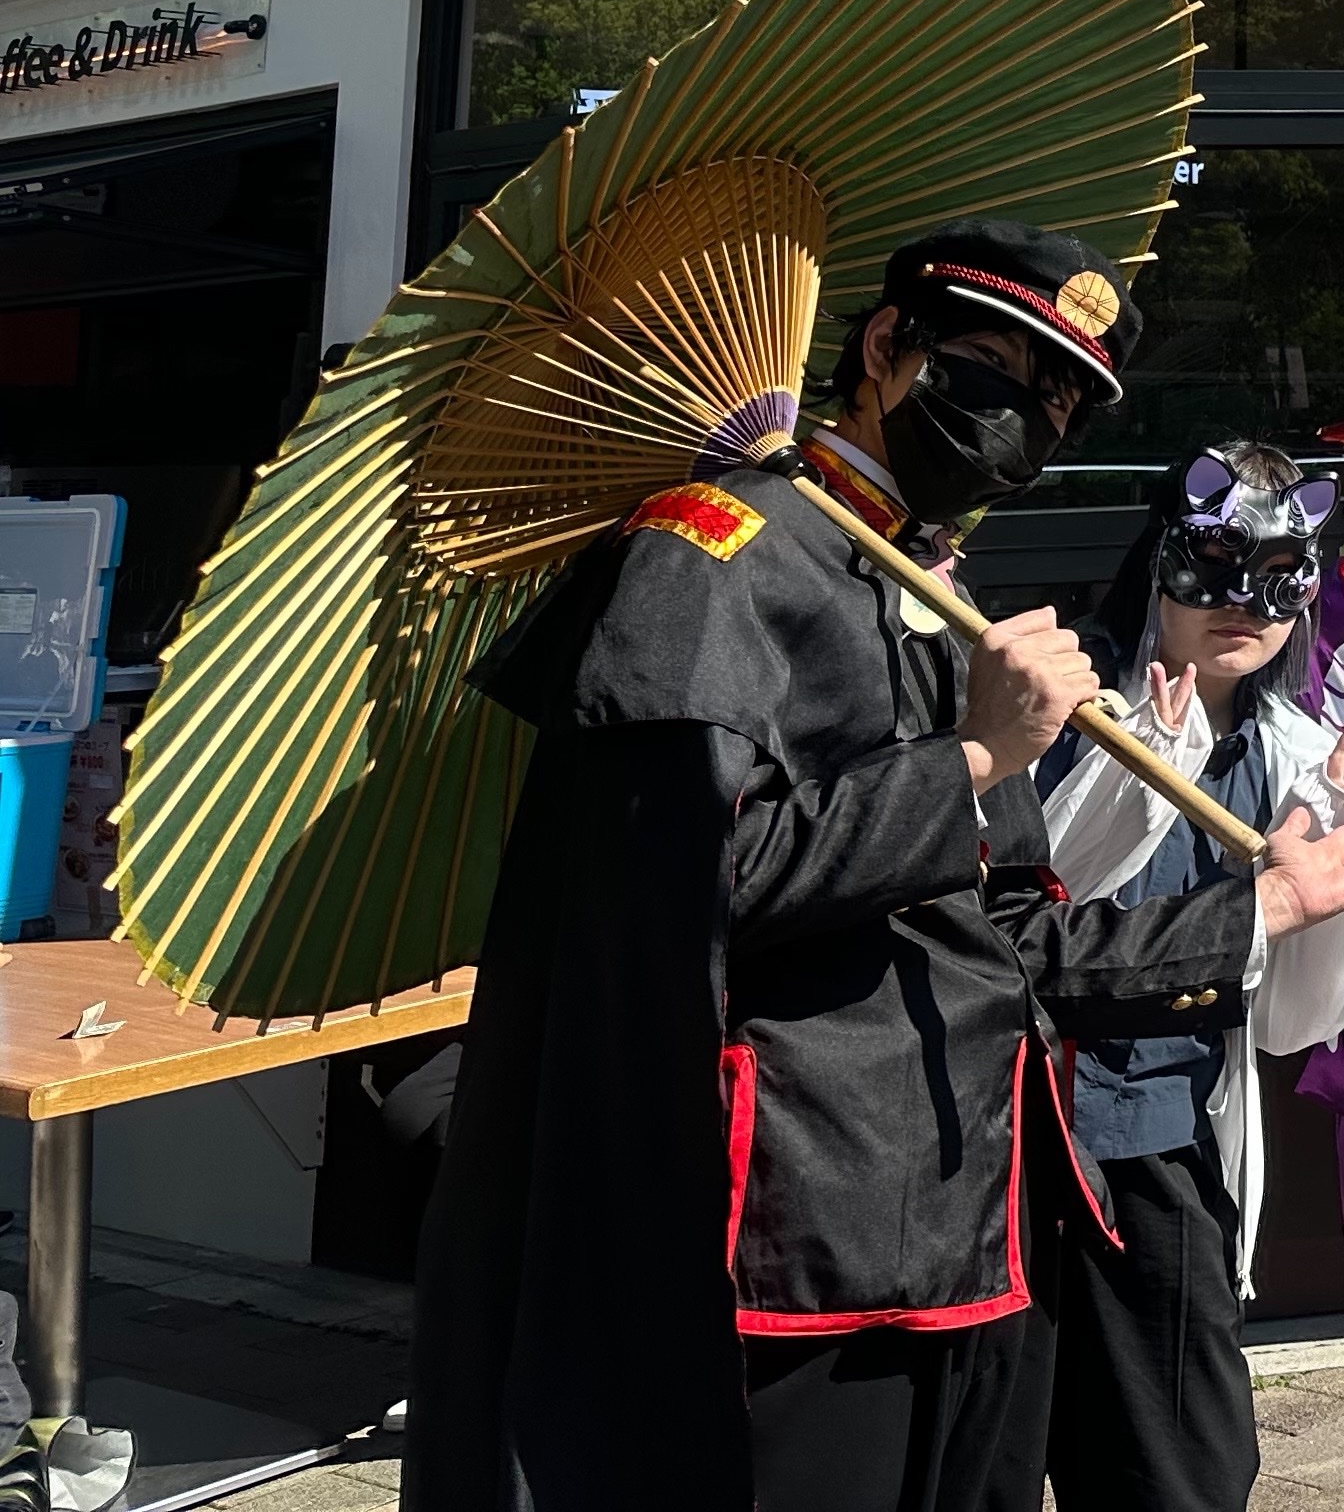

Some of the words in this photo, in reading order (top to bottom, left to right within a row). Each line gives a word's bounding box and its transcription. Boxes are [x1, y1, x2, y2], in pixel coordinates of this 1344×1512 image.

[0, 35, 65, 93] ffee
[68, 26, 98, 81] &
[100, 1, 205, 73] Drink
